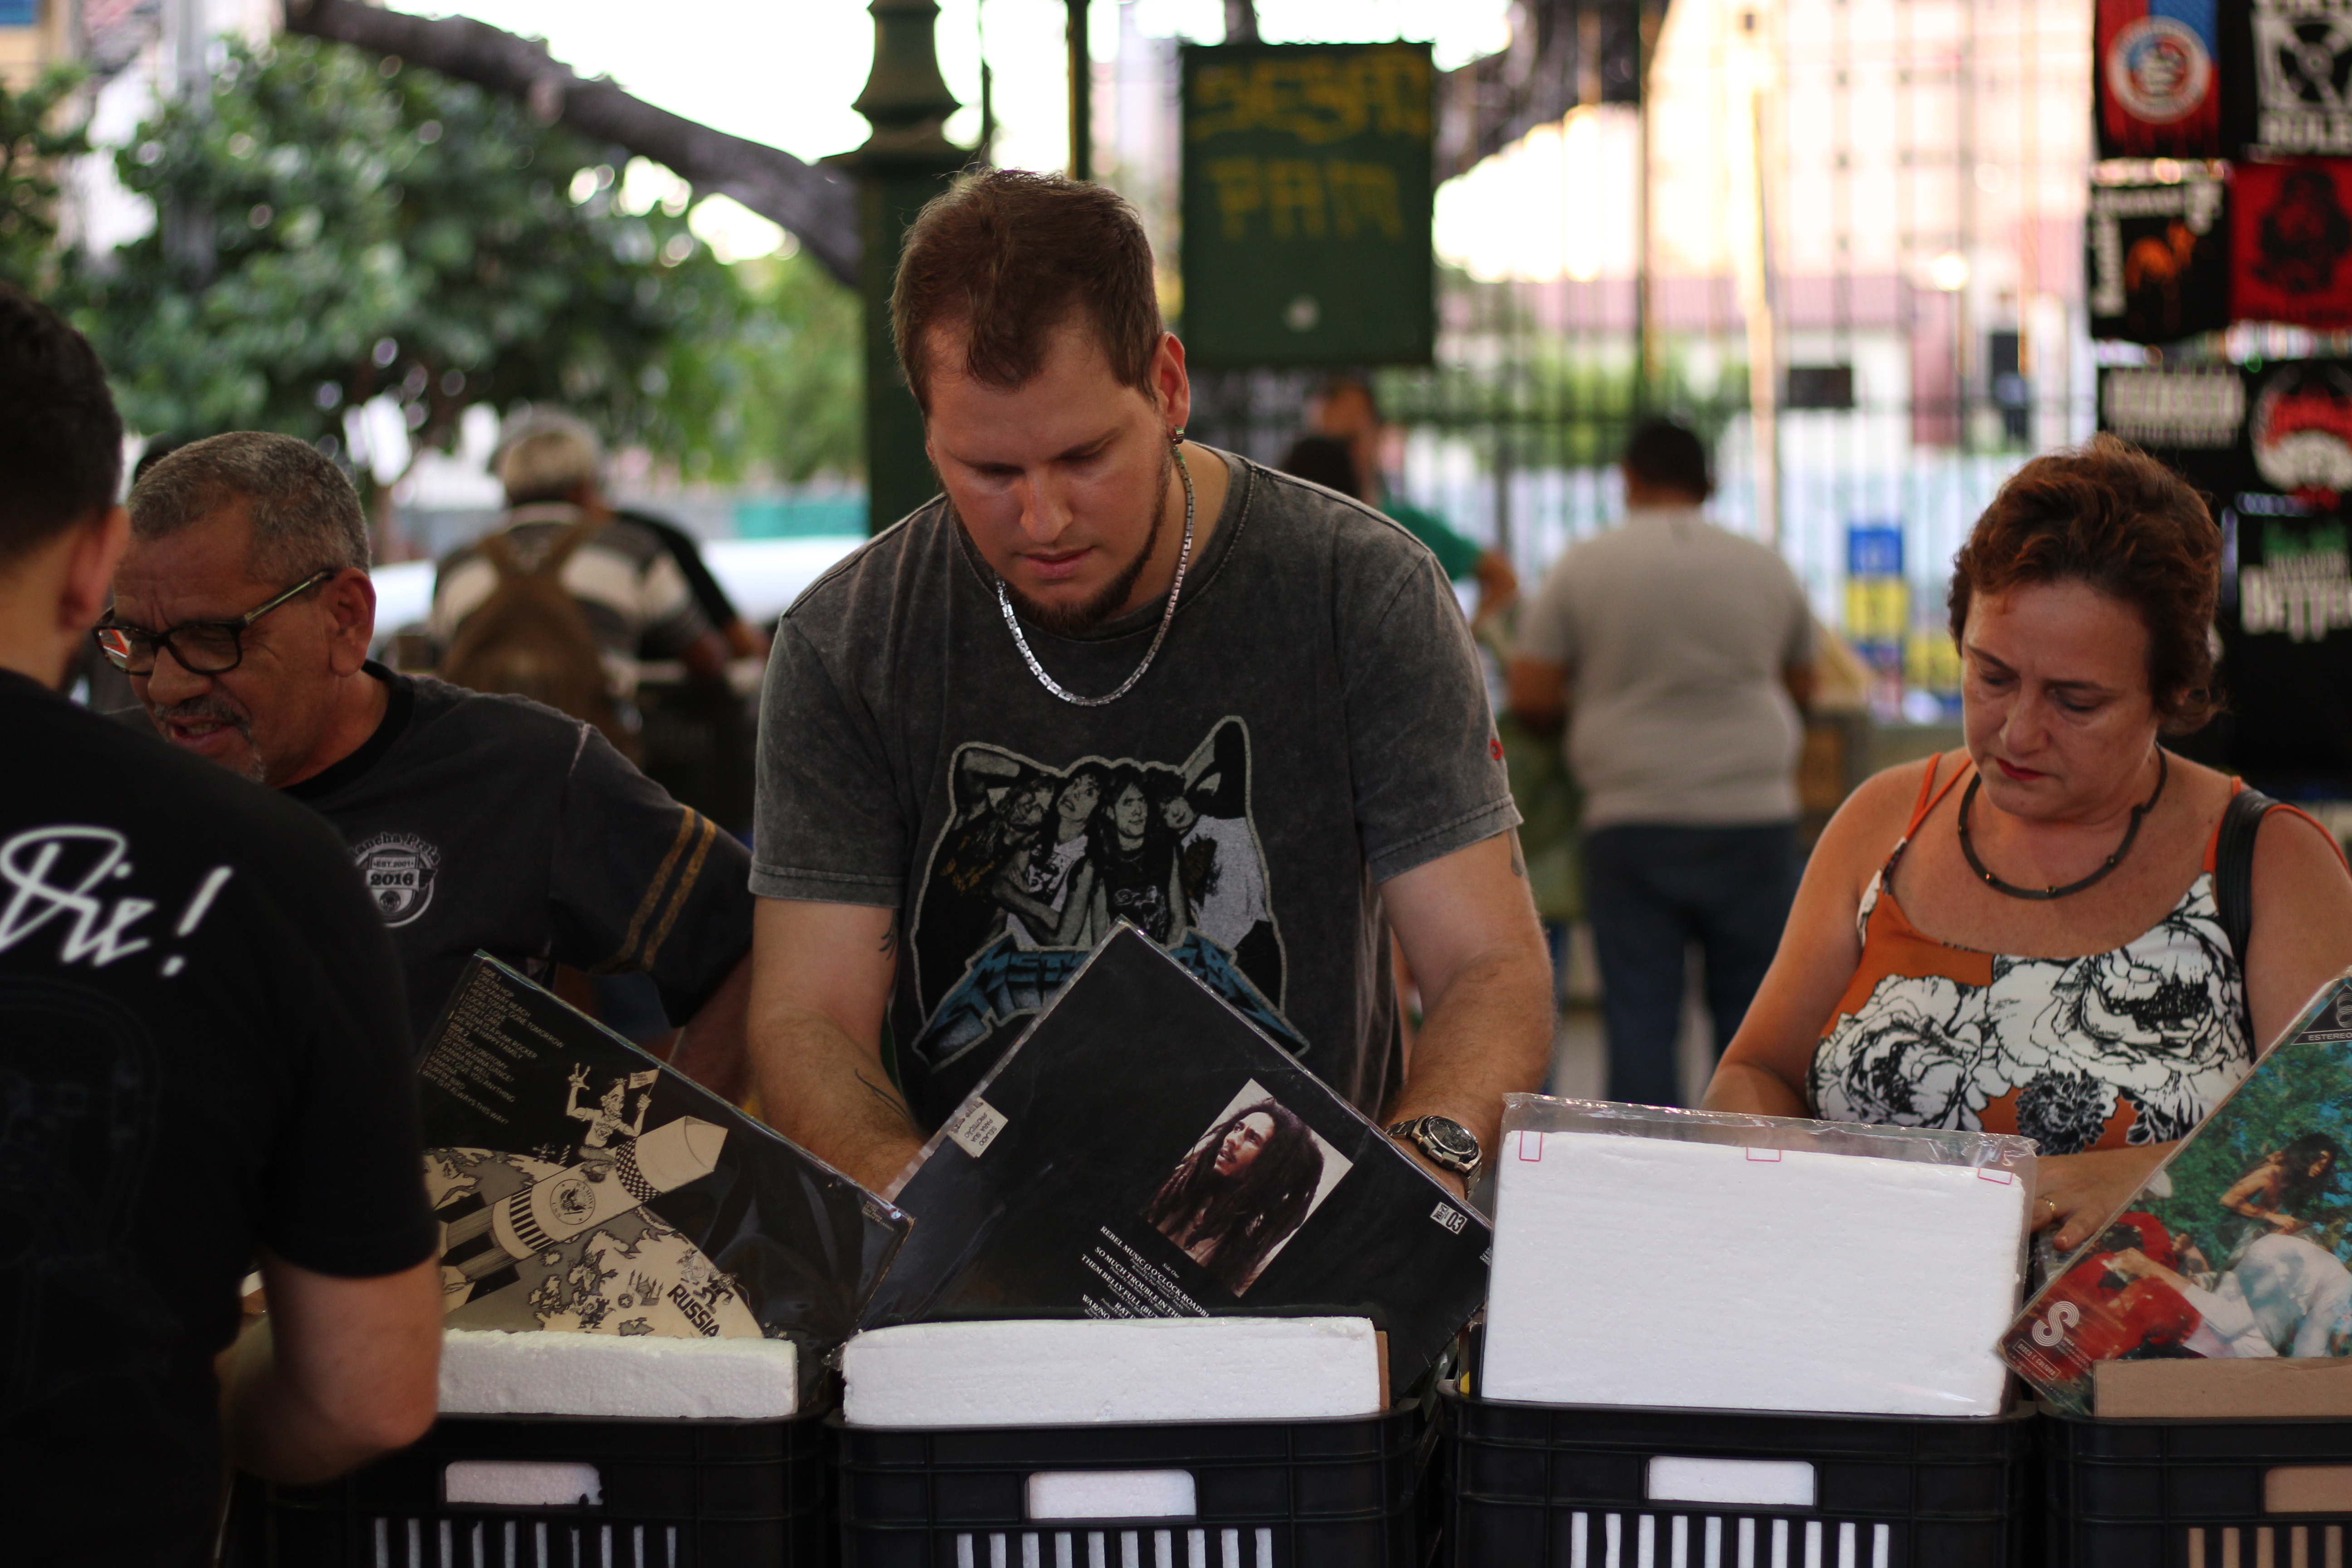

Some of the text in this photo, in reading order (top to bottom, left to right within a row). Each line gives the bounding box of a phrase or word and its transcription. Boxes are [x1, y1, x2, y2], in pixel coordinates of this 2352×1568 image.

[404, 833, 440, 866] Preta
[371, 872, 414, 885] 2016
[478, 974, 514, 997] CRETIN HOP
[481, 967, 497, 979] SIDE
[466, 994, 507, 1022] LOCKET LOVE
[474, 980, 531, 1018] ROCKAWAY BEACH
[449, 1022, 465, 1034] SIDE
[470, 988, 487, 1001] HERE
[509, 1011, 527, 1025] GONE
[528, 1022, 564, 1049] TOMORROW
[484, 1014, 502, 1028] CARE
[458, 1008, 484, 1026] SHEENA
[495, 1030, 512, 1044] PUNK
[512, 1041, 538, 1060] ROCKER
[479, 1030, 500, 1045] HAPPY
[499, 1043, 524, 1060] FAMILY
[440, 1045, 466, 1062] WANNA
[464, 1058, 475, 1068] BE
[473, 1064, 491, 1079] WELL
[441, 1035, 515, 1083] DO YOU WANNA DANCE?
[446, 1029, 509, 1070] TEENAGE LOBOTOMY
[430, 1055, 458, 1076] RAMONA
[449, 1077, 466, 1090] BIRD
[455, 1062, 471, 1075] GIVE
[470, 1071, 484, 1083] YOU
[482, 1080, 516, 1103] ANYTHING
[422, 1069, 439, 1081] WHY
[436, 1078, 445, 1086] IS
[449, 1087, 477, 1106] ALWAYS
[475, 1102, 491, 1115] THIS
[490, 1111, 509, 1125] WAY?
[970, 1118, 993, 1142] PARA SUA
[979, 1126, 997, 1146] SELADO
[1446, 1212, 1465, 1232] 03
[1100, 1225, 1123, 1248] REBEL
[1122, 1245, 1146, 1265] MUSIC
[1151, 1269, 1183, 1297] O'CLOCK
[1109, 1266, 1124, 1279] Produced
[1130, 1258, 1145, 1271] Produced
[1162, 1262, 1180, 1279] Side One
[1082, 1254, 1103, 1275] THEM
[1101, 1271, 1125, 1292] BELLY
[1122, 1289, 1141, 1308] FULL
[1094, 1246, 1106, 1257] SO
[1104, 1254, 1127, 1275] MUCH
[1126, 1272, 1160, 1302] TROUBLE
[1157, 1298, 1168, 1309] IN
[666, 1283, 720, 1337] RUSSIA
[1082, 1294, 1110, 1319] WAR/NO
[1114, 1302, 1131, 1317] RAT
[2017, 1343, 2033, 1357] DISCO
[2035, 1357, 2056, 1376] CULTURA
